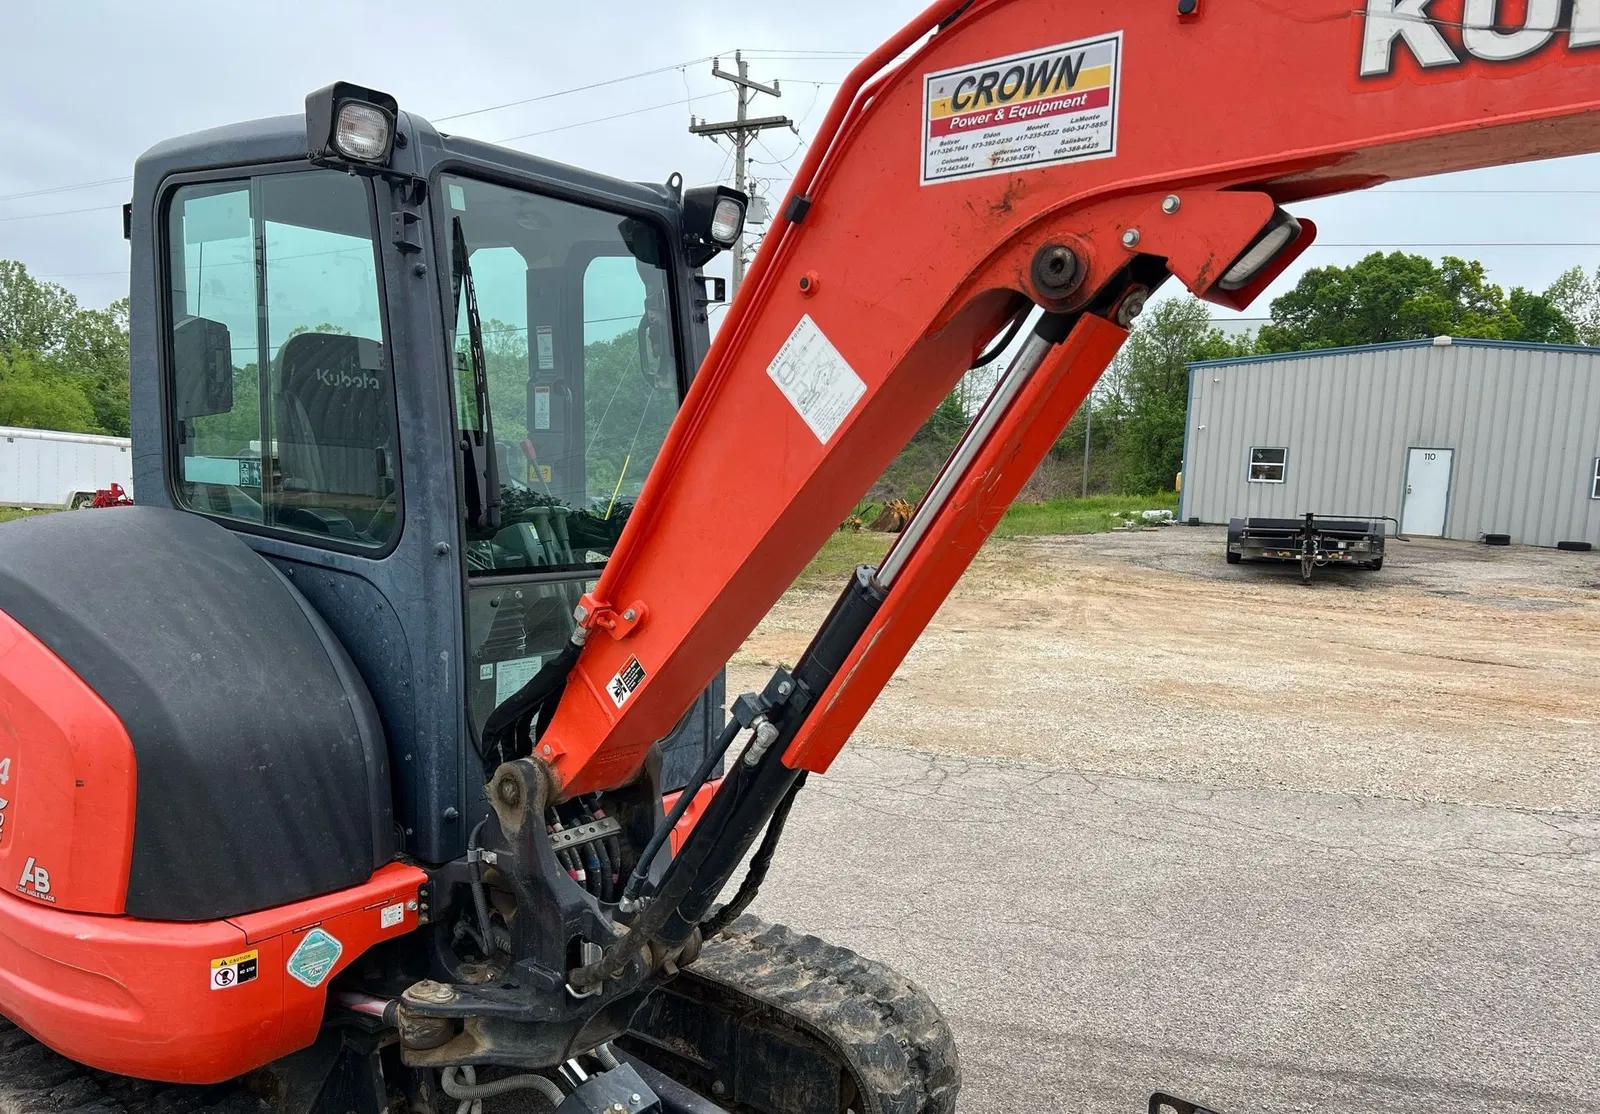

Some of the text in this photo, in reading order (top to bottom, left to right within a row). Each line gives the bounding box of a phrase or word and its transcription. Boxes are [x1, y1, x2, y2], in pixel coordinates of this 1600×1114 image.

[1360, 0, 1600, 76] KU
[951, 52, 1085, 111] CROWN
[949, 93, 1088, 130] Power & Equipment
[1070, 114, 1100, 124] LaMonte
[1026, 122, 1050, 132] Monett
[1061, 120, 1108, 134] 660-347-5855
[983, 131, 1001, 140] Eldon
[1015, 128, 1060, 141] 417-235-5222
[939, 138, 961, 147] Bolivar
[1060, 135, 1093, 146] Salisbury
[991, 145, 1036, 157] Jefferson City
[941, 155, 970, 165] Columbia
[791, 320, 807, 341] POINTS
[316, 368, 380, 390] Kubota
[1424, 453, 1436, 461] 110
[229, 954, 251, 964] CAUTION
